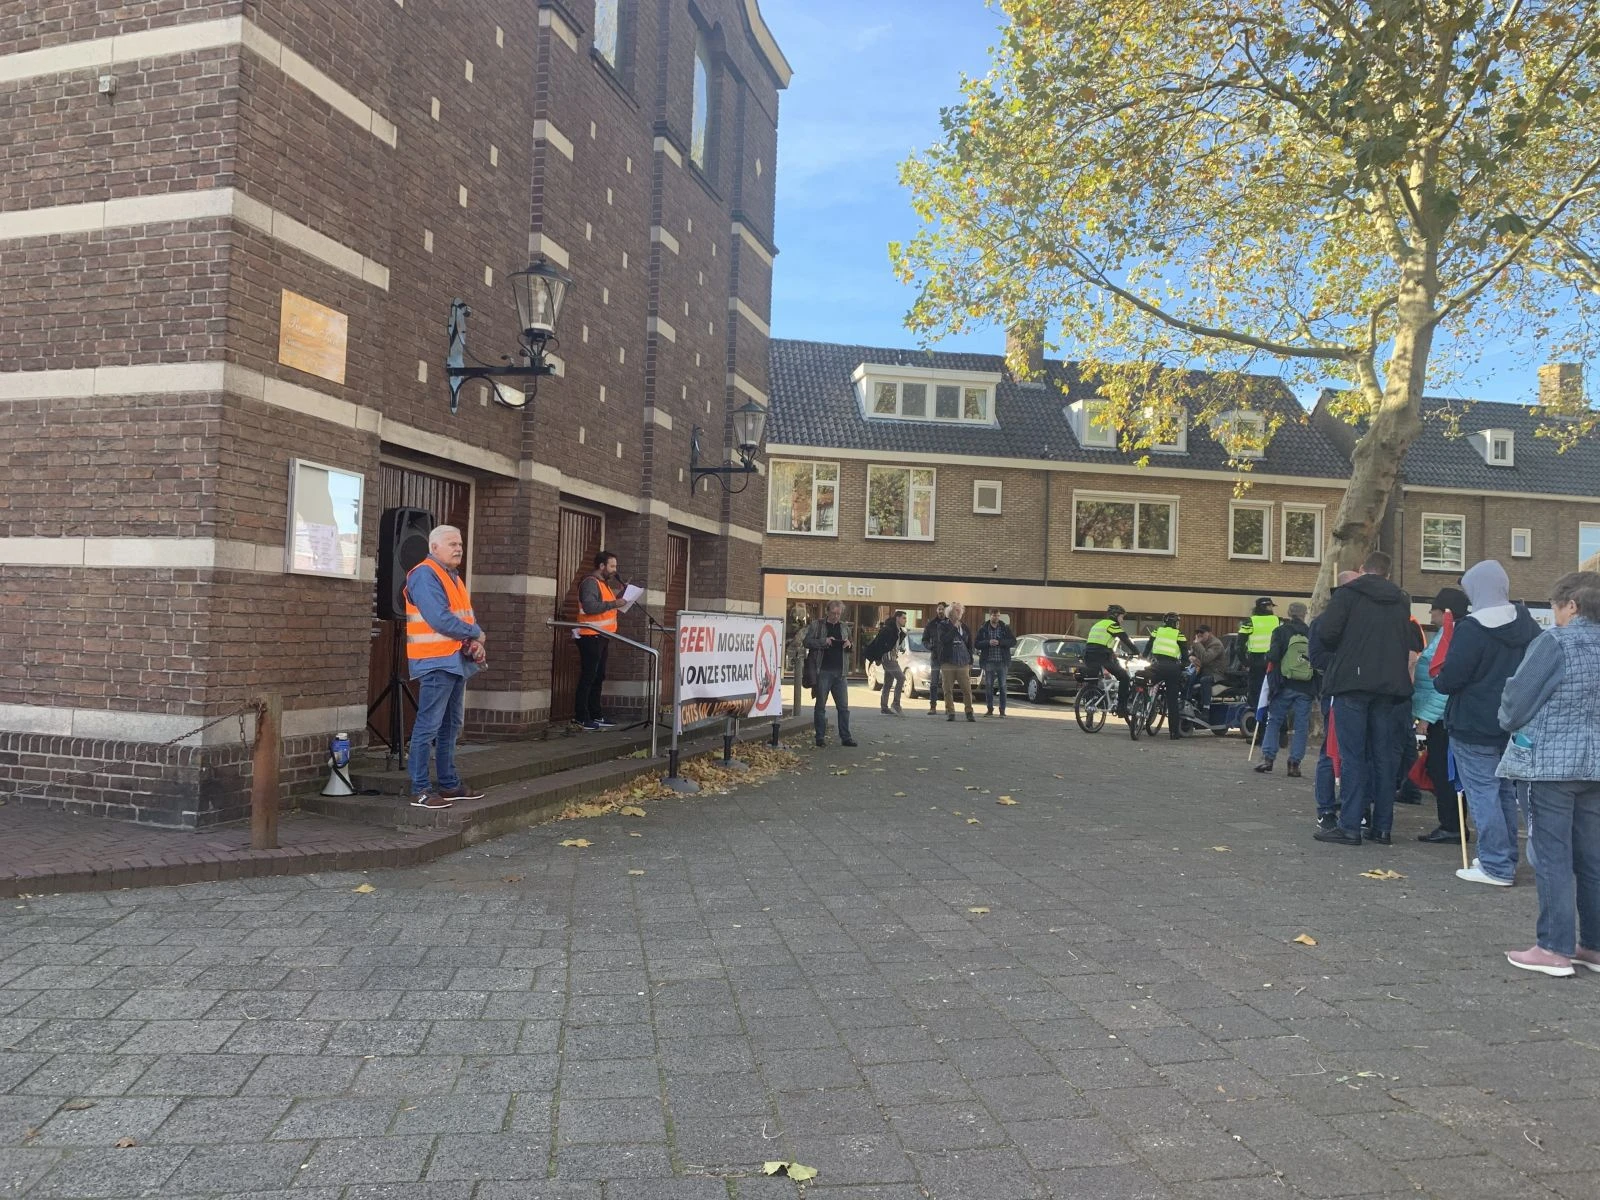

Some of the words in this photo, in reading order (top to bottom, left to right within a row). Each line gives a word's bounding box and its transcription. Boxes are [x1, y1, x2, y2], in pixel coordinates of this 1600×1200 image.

[787, 579, 842, 595] kondor
[848, 582, 876, 597] hair
[680, 626, 715, 653] GEEN
[717, 633, 755, 652] MOSKEE
[686, 665, 718, 685] ONZE
[720, 664, 754, 683] STRAAT
